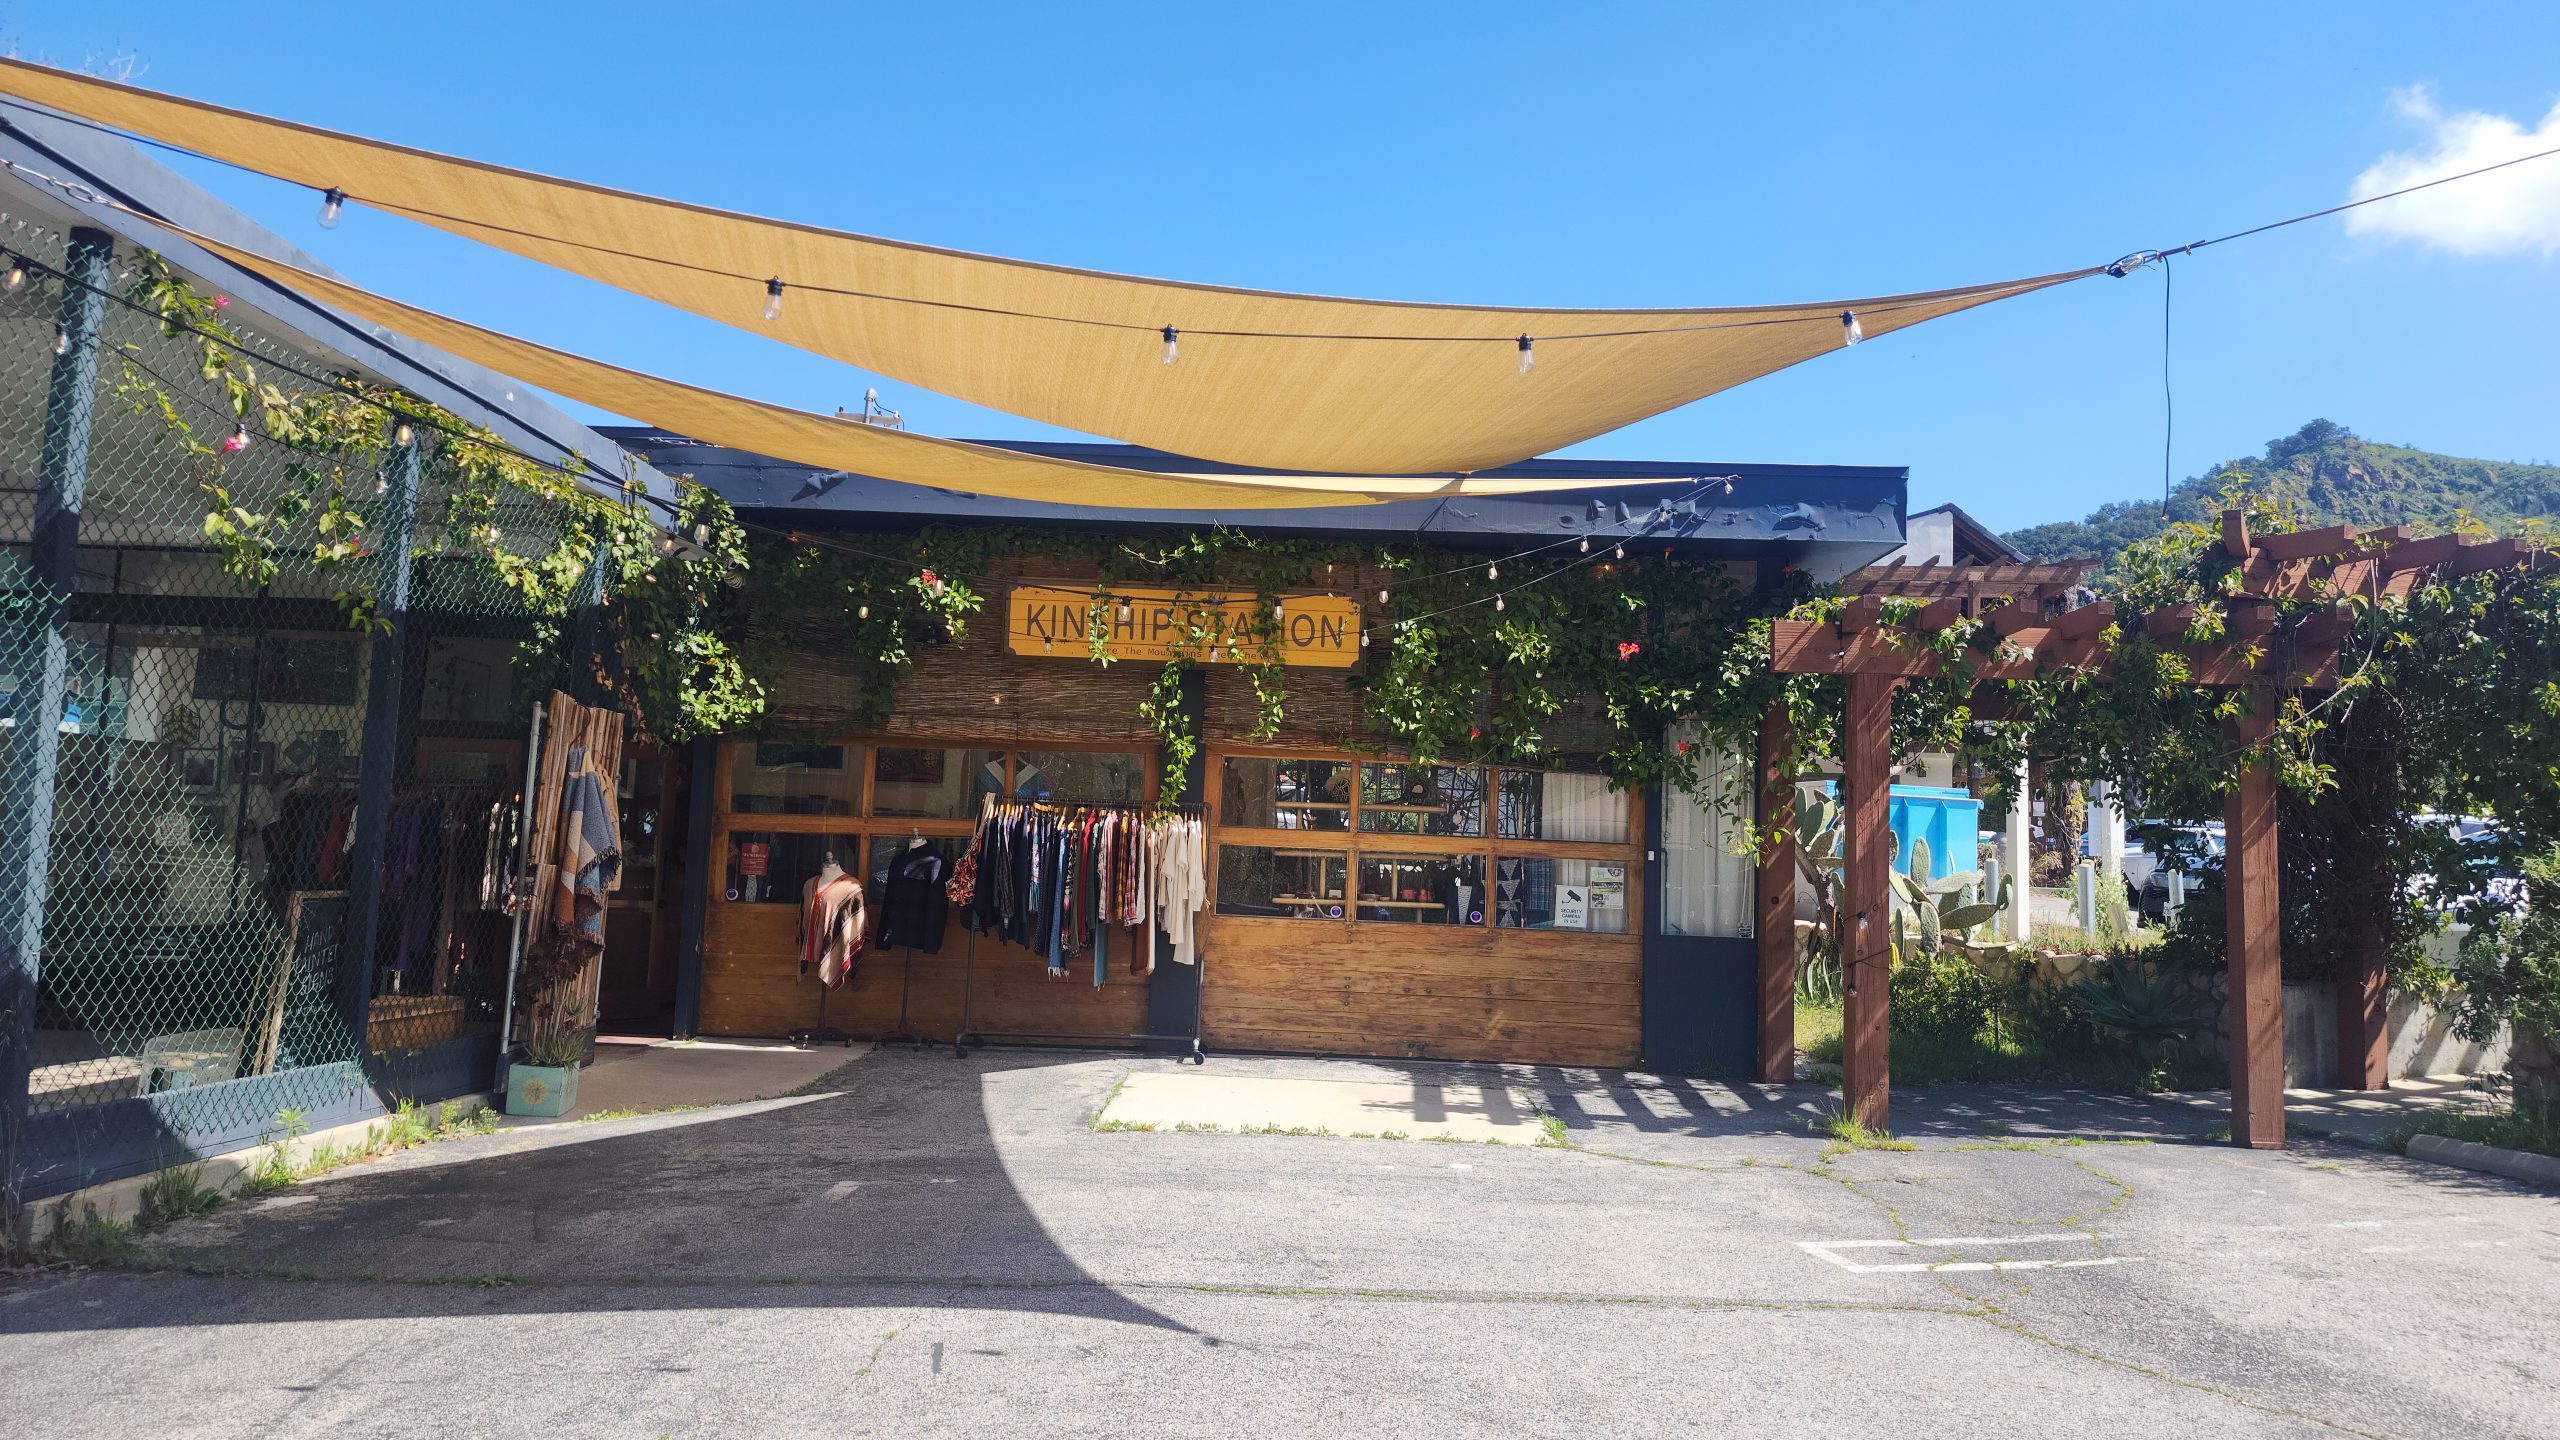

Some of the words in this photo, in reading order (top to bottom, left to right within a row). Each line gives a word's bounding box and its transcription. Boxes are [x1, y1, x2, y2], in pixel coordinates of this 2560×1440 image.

[1186, 609, 1344, 649] STAION
[1124, 646, 1142, 656] The
[1147, 647, 1202, 658] Mounains
